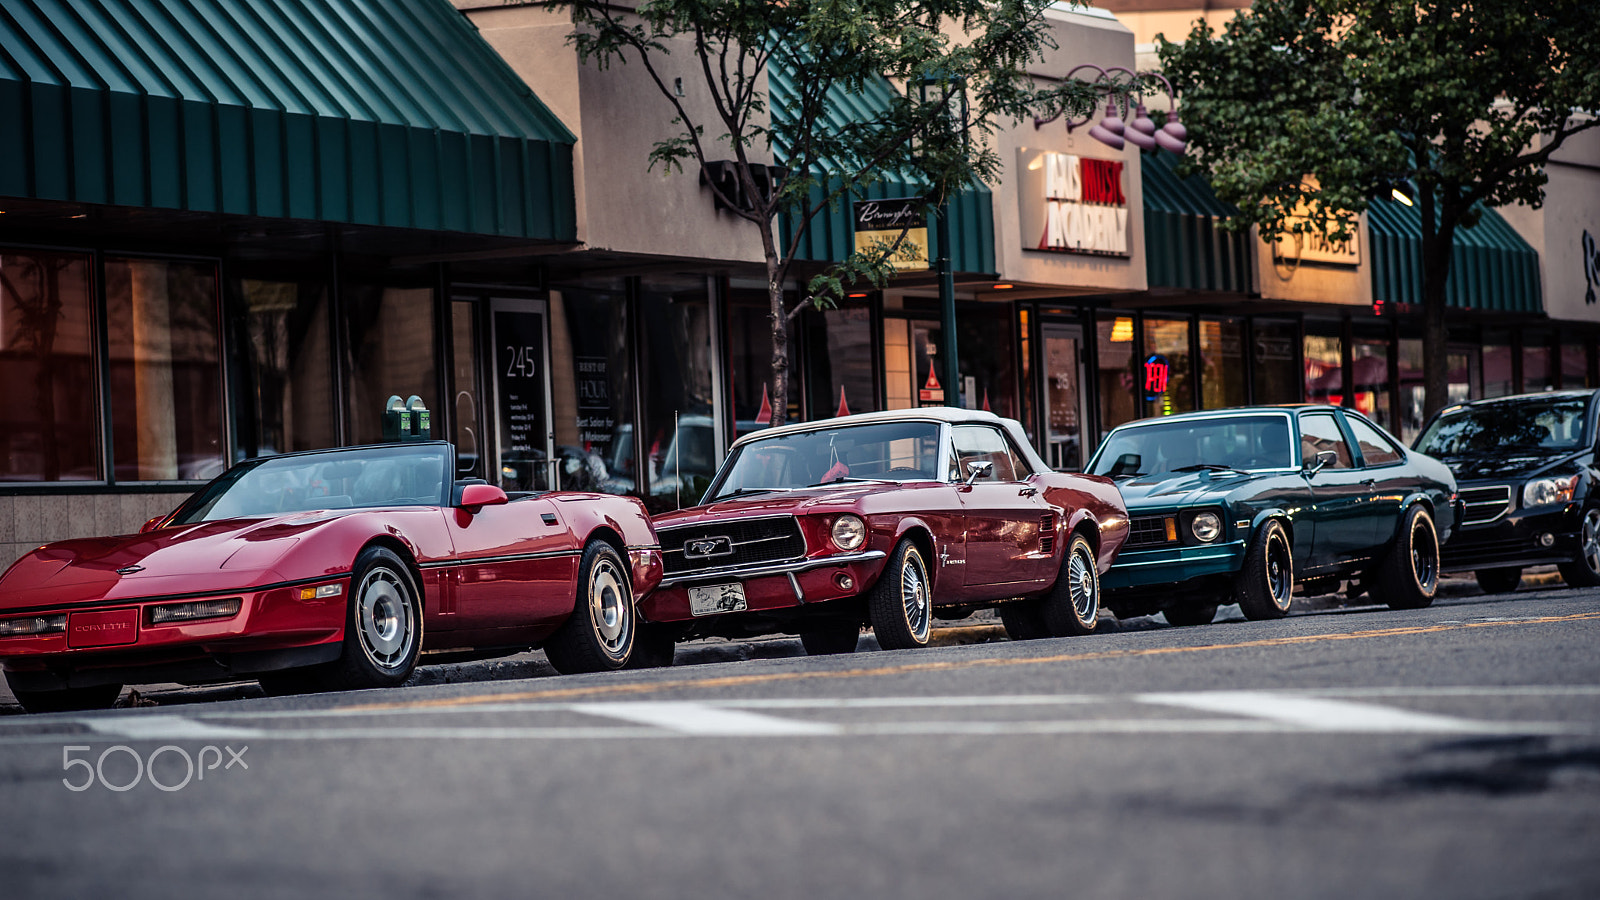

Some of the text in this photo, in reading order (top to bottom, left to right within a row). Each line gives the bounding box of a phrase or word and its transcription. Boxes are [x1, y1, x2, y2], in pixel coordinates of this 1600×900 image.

[1080, 157, 1127, 205] MUSIC
[859, 202, 921, 225] Birmingha
[1047, 201, 1129, 252] ACADEMY
[506, 346, 535, 378] 245
[579, 379, 608, 399] HOUR
[75, 622, 130, 632] CORVETTE
